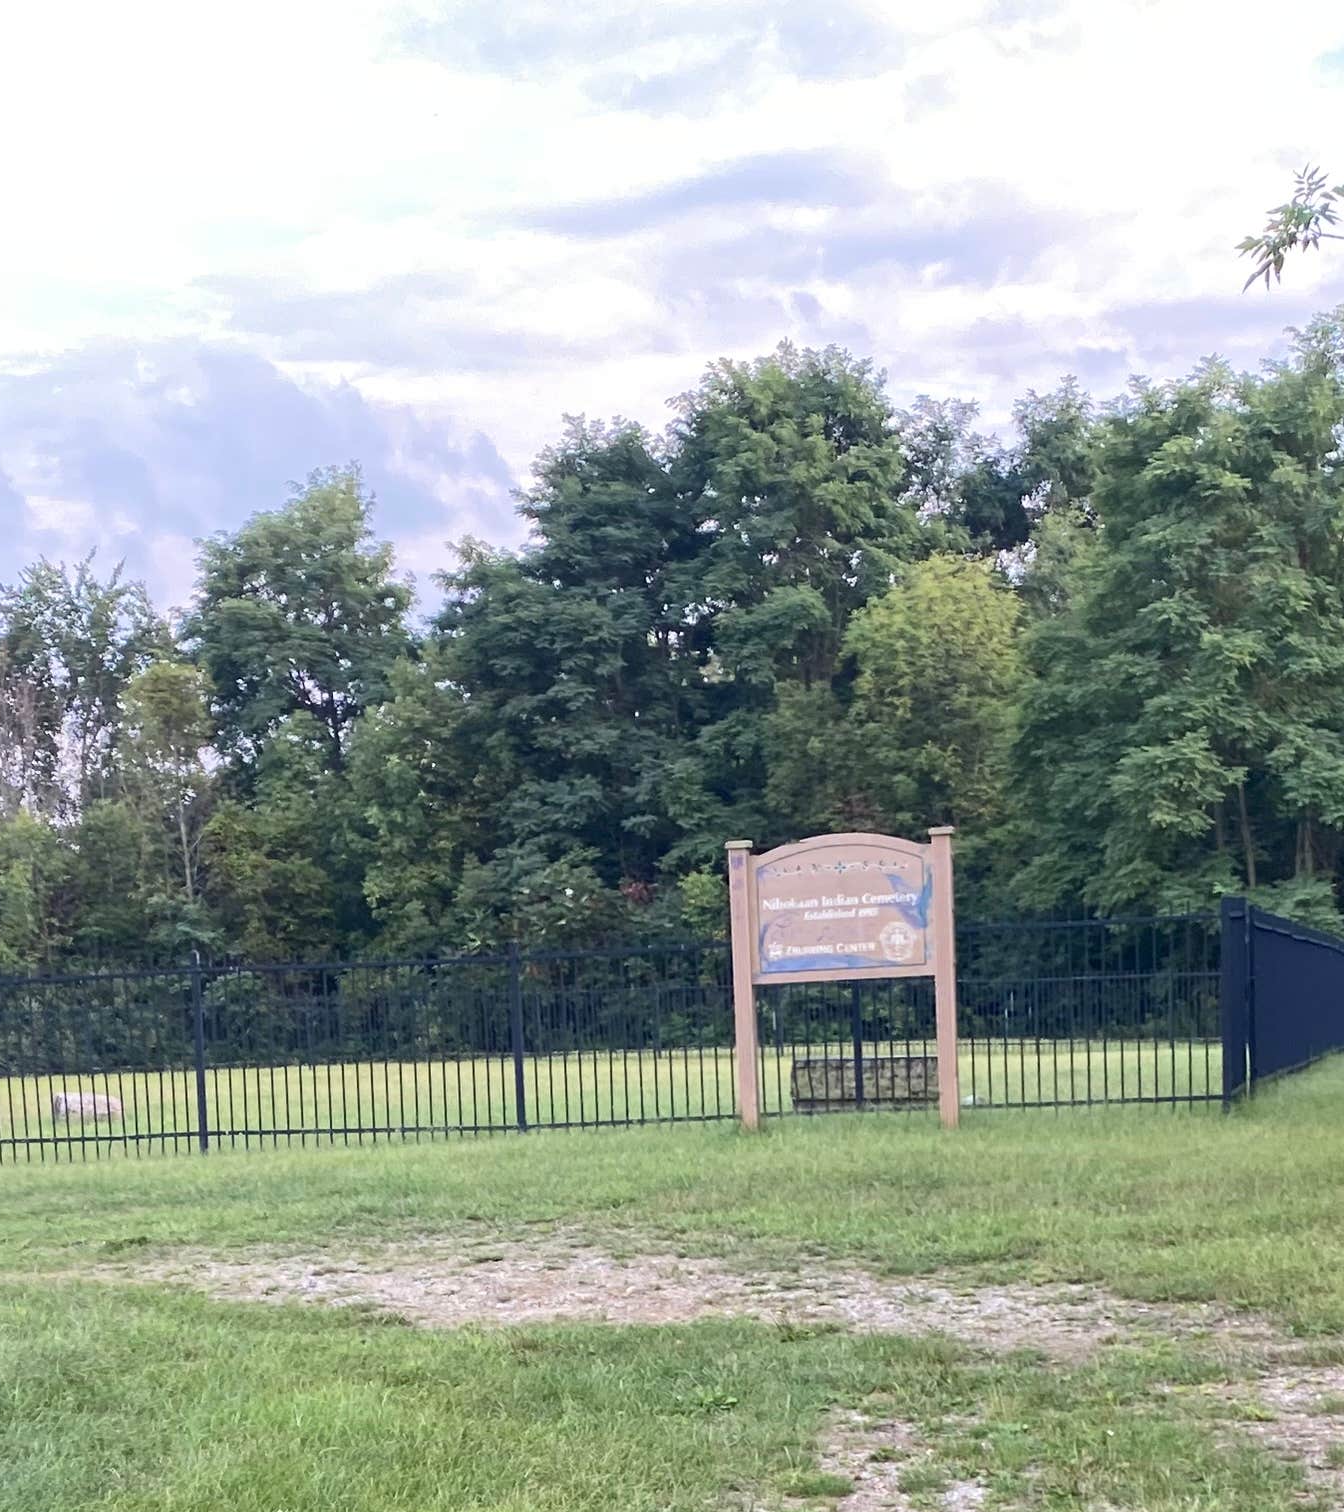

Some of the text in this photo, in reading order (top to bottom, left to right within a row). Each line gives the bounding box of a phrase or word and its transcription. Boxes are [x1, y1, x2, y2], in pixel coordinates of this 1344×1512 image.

[821, 894, 859, 907] Indian
[862, 892, 918, 906] Cemetery
[803, 908, 855, 921] Established
[836, 941, 876, 954] CENTER
